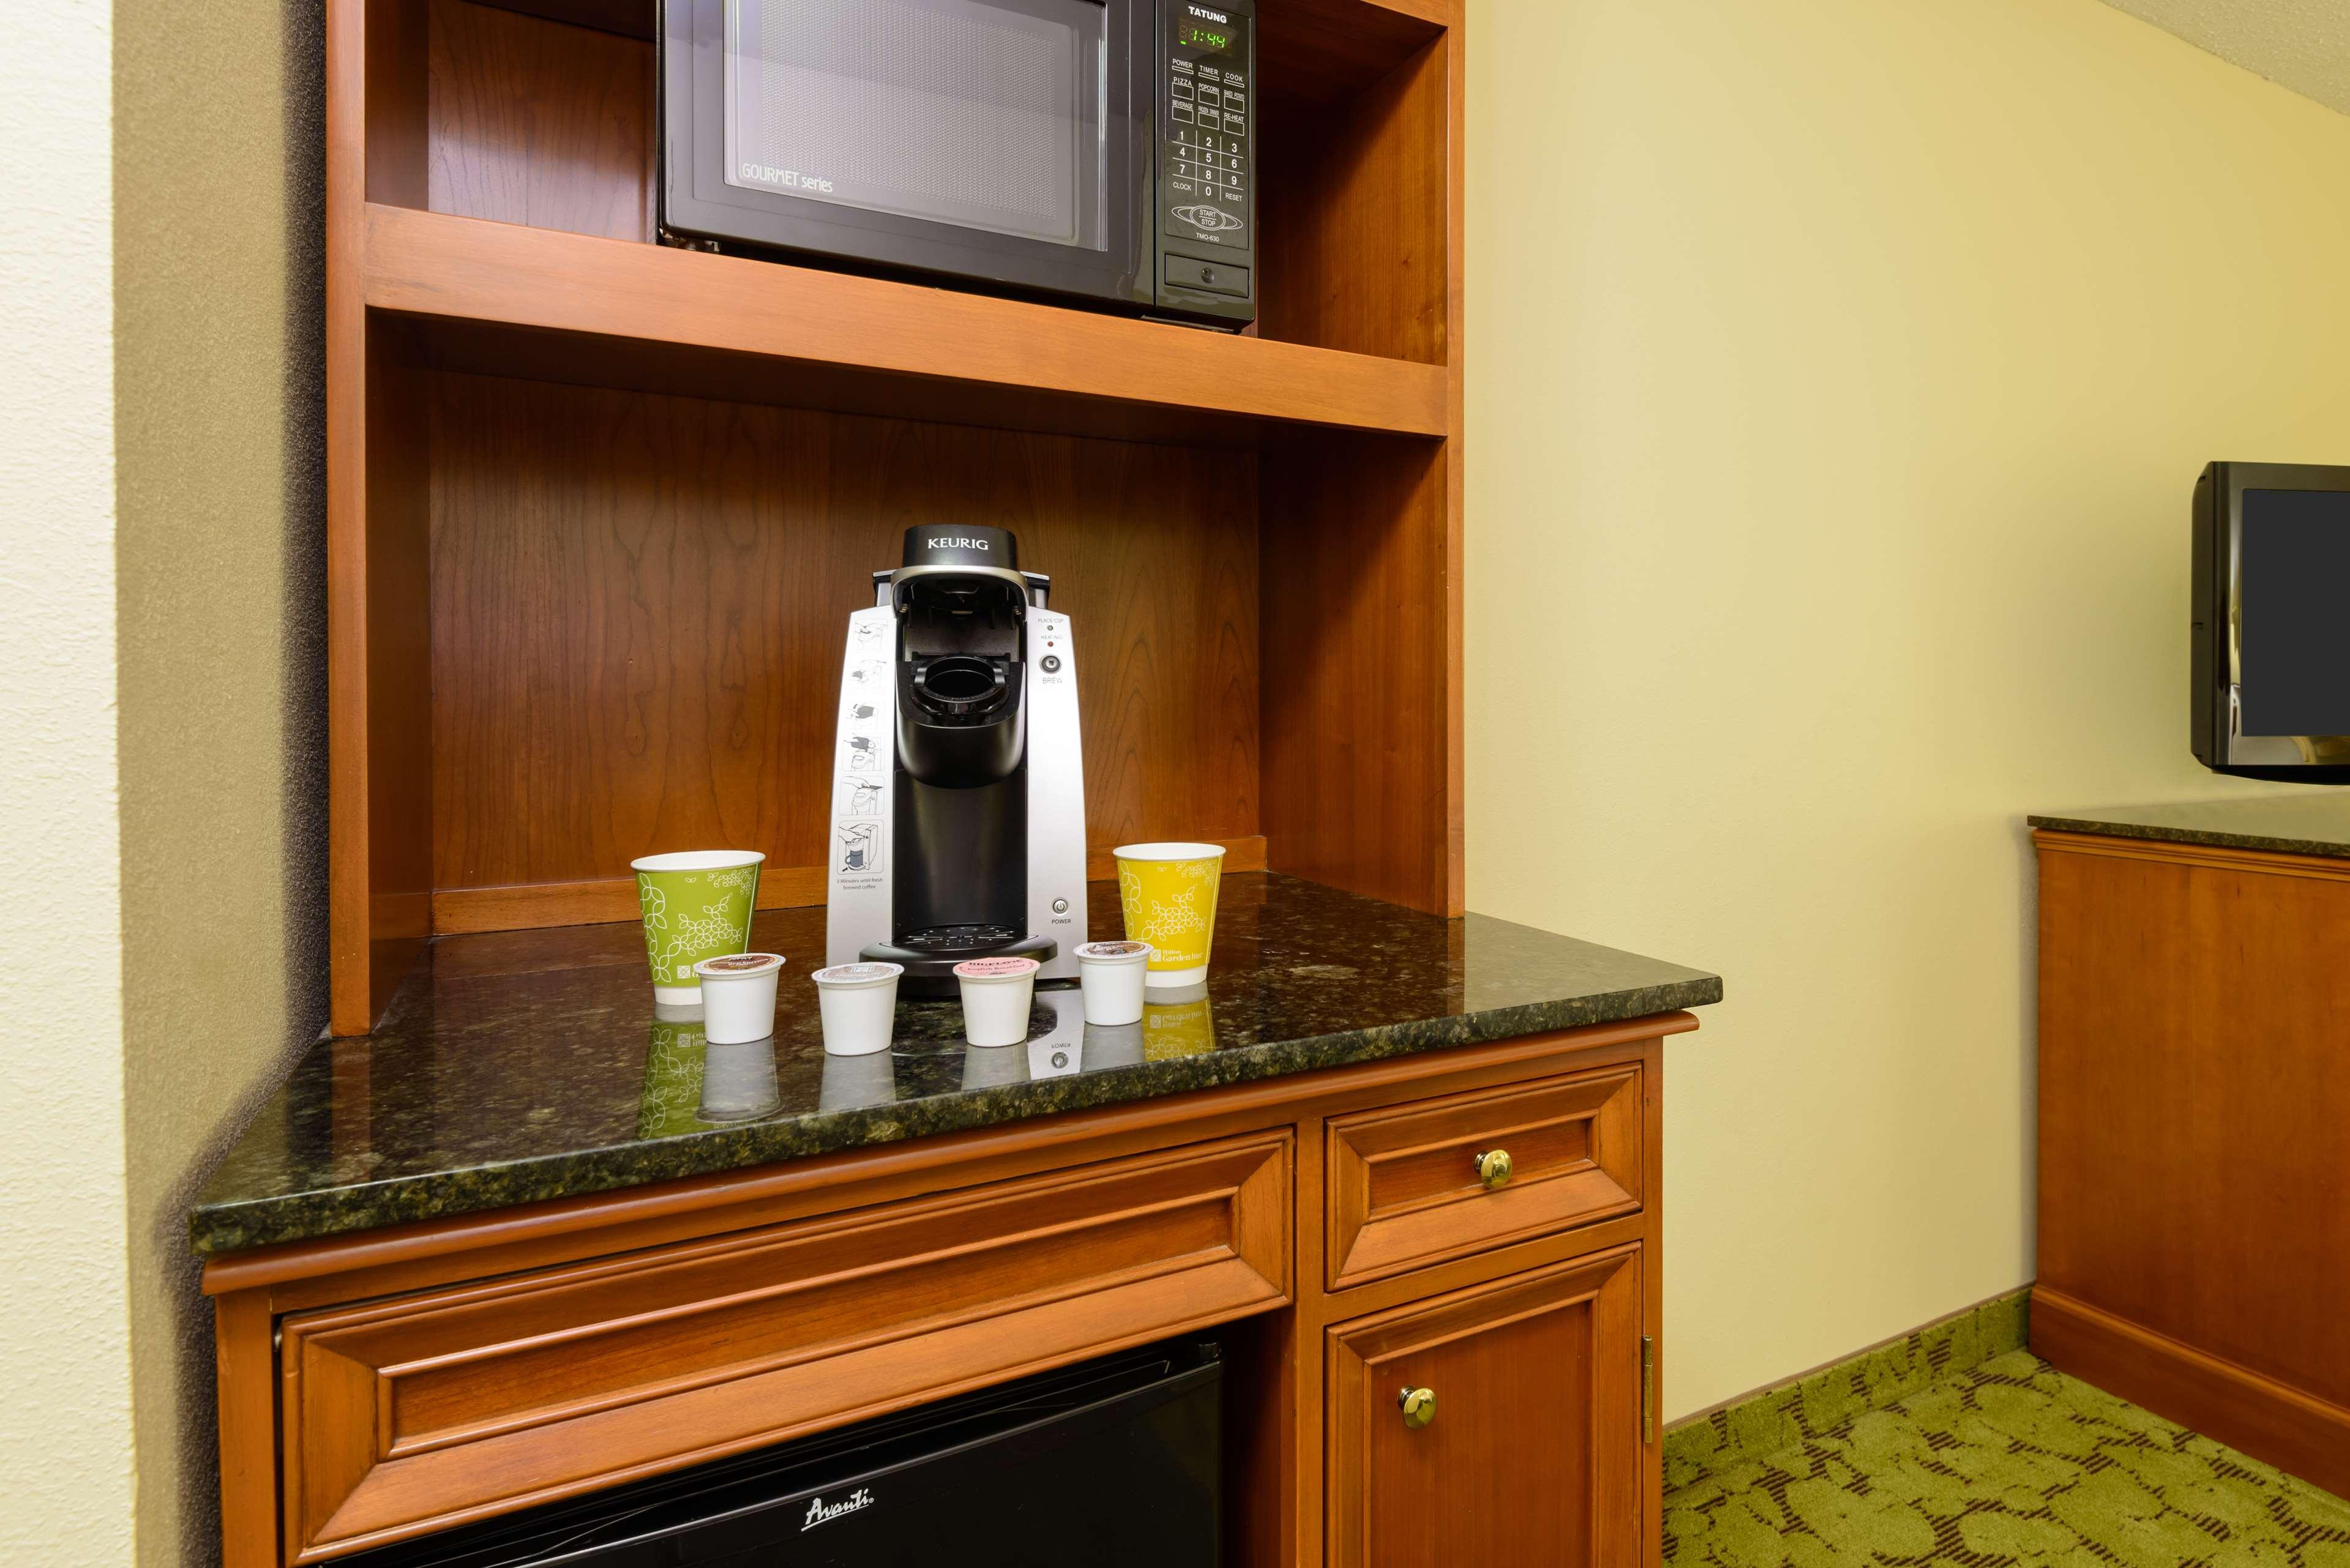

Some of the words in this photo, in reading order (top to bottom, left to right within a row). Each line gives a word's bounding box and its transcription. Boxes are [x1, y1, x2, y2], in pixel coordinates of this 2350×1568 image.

[1188, 6, 1227, 24] TATUNG
[1194, 30, 1226, 48] 1:44
[1172, 58, 1193, 69] POWER
[1199, 65, 1219, 76] TIMER
[1173, 77, 1192, 86] PIZZA
[1226, 72, 1243, 83] COOK
[1199, 83, 1219, 93] POPCORN
[1172, 99, 1193, 110] BEVERAGE
[1224, 112, 1244, 122] RE-HEAT
[1180, 130, 1184, 140] 1
[1206, 137, 1211, 147] 2
[1180, 147, 1186, 157] 4
[1232, 143, 1237, 152] 3
[1206, 153, 1211, 163] 5
[1232, 159, 1237, 168] 6
[1180, 165, 1185, 174] 7
[743, 163, 799, 187] GOURMET
[801, 177, 833, 192] series
[1206, 170, 1211, 180] 8
[1232, 176, 1237, 185] 9
[1173, 181, 1191, 191] CLOCK
[1205, 186, 1211, 196] 0
[1225, 193, 1243, 201] RESET
[1199, 209, 1216, 218] START
[1201, 218, 1216, 227] STOP
[1196, 233, 1219, 242] TMO-630
[928, 538, 989, 550] KEURIG
[805, 1488, 869, 1525] Avanti
